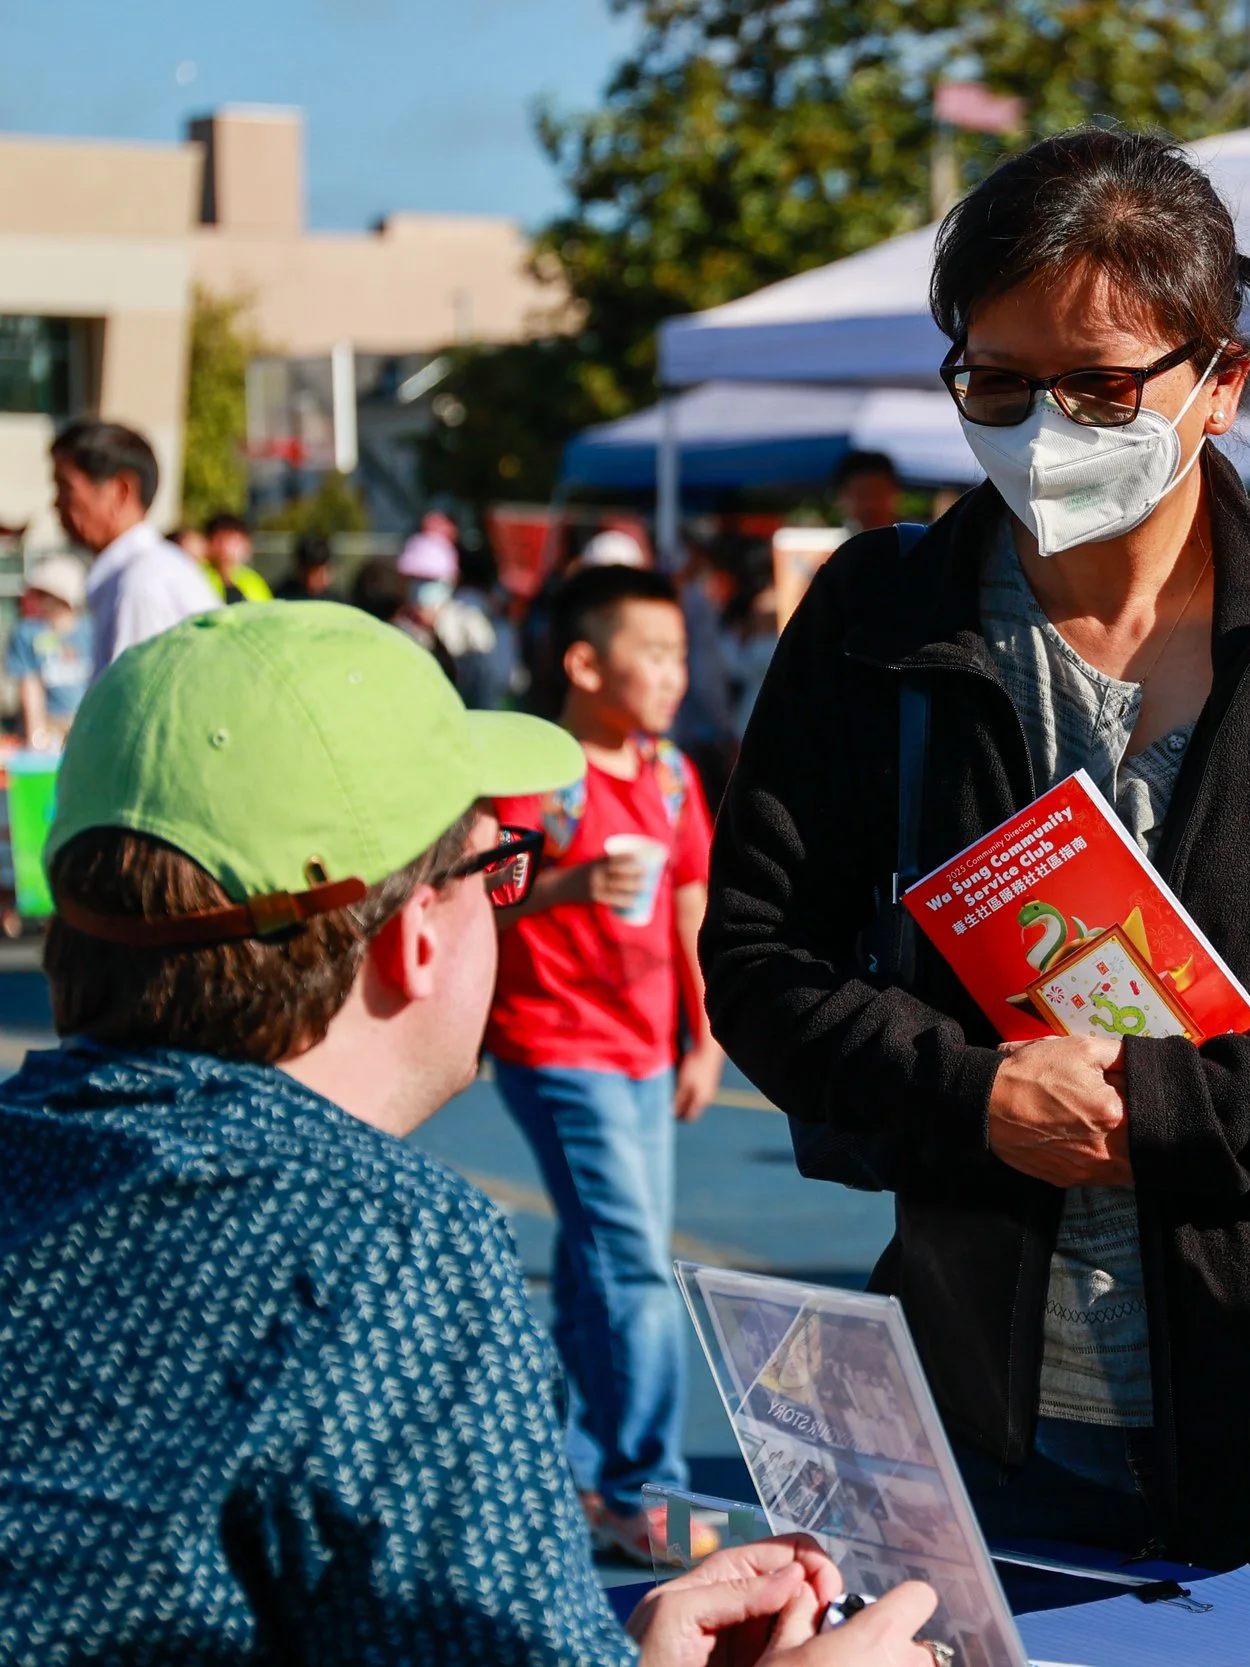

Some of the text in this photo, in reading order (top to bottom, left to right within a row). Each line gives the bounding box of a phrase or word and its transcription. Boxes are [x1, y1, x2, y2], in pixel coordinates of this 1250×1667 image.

[925, 806, 1073, 912] Wa Sung Community
[945, 817, 1037, 883] 2025 Community Directory
[951, 835, 1088, 936] 華生社區服務社社區指南
[964, 840, 1054, 907] Service Club
